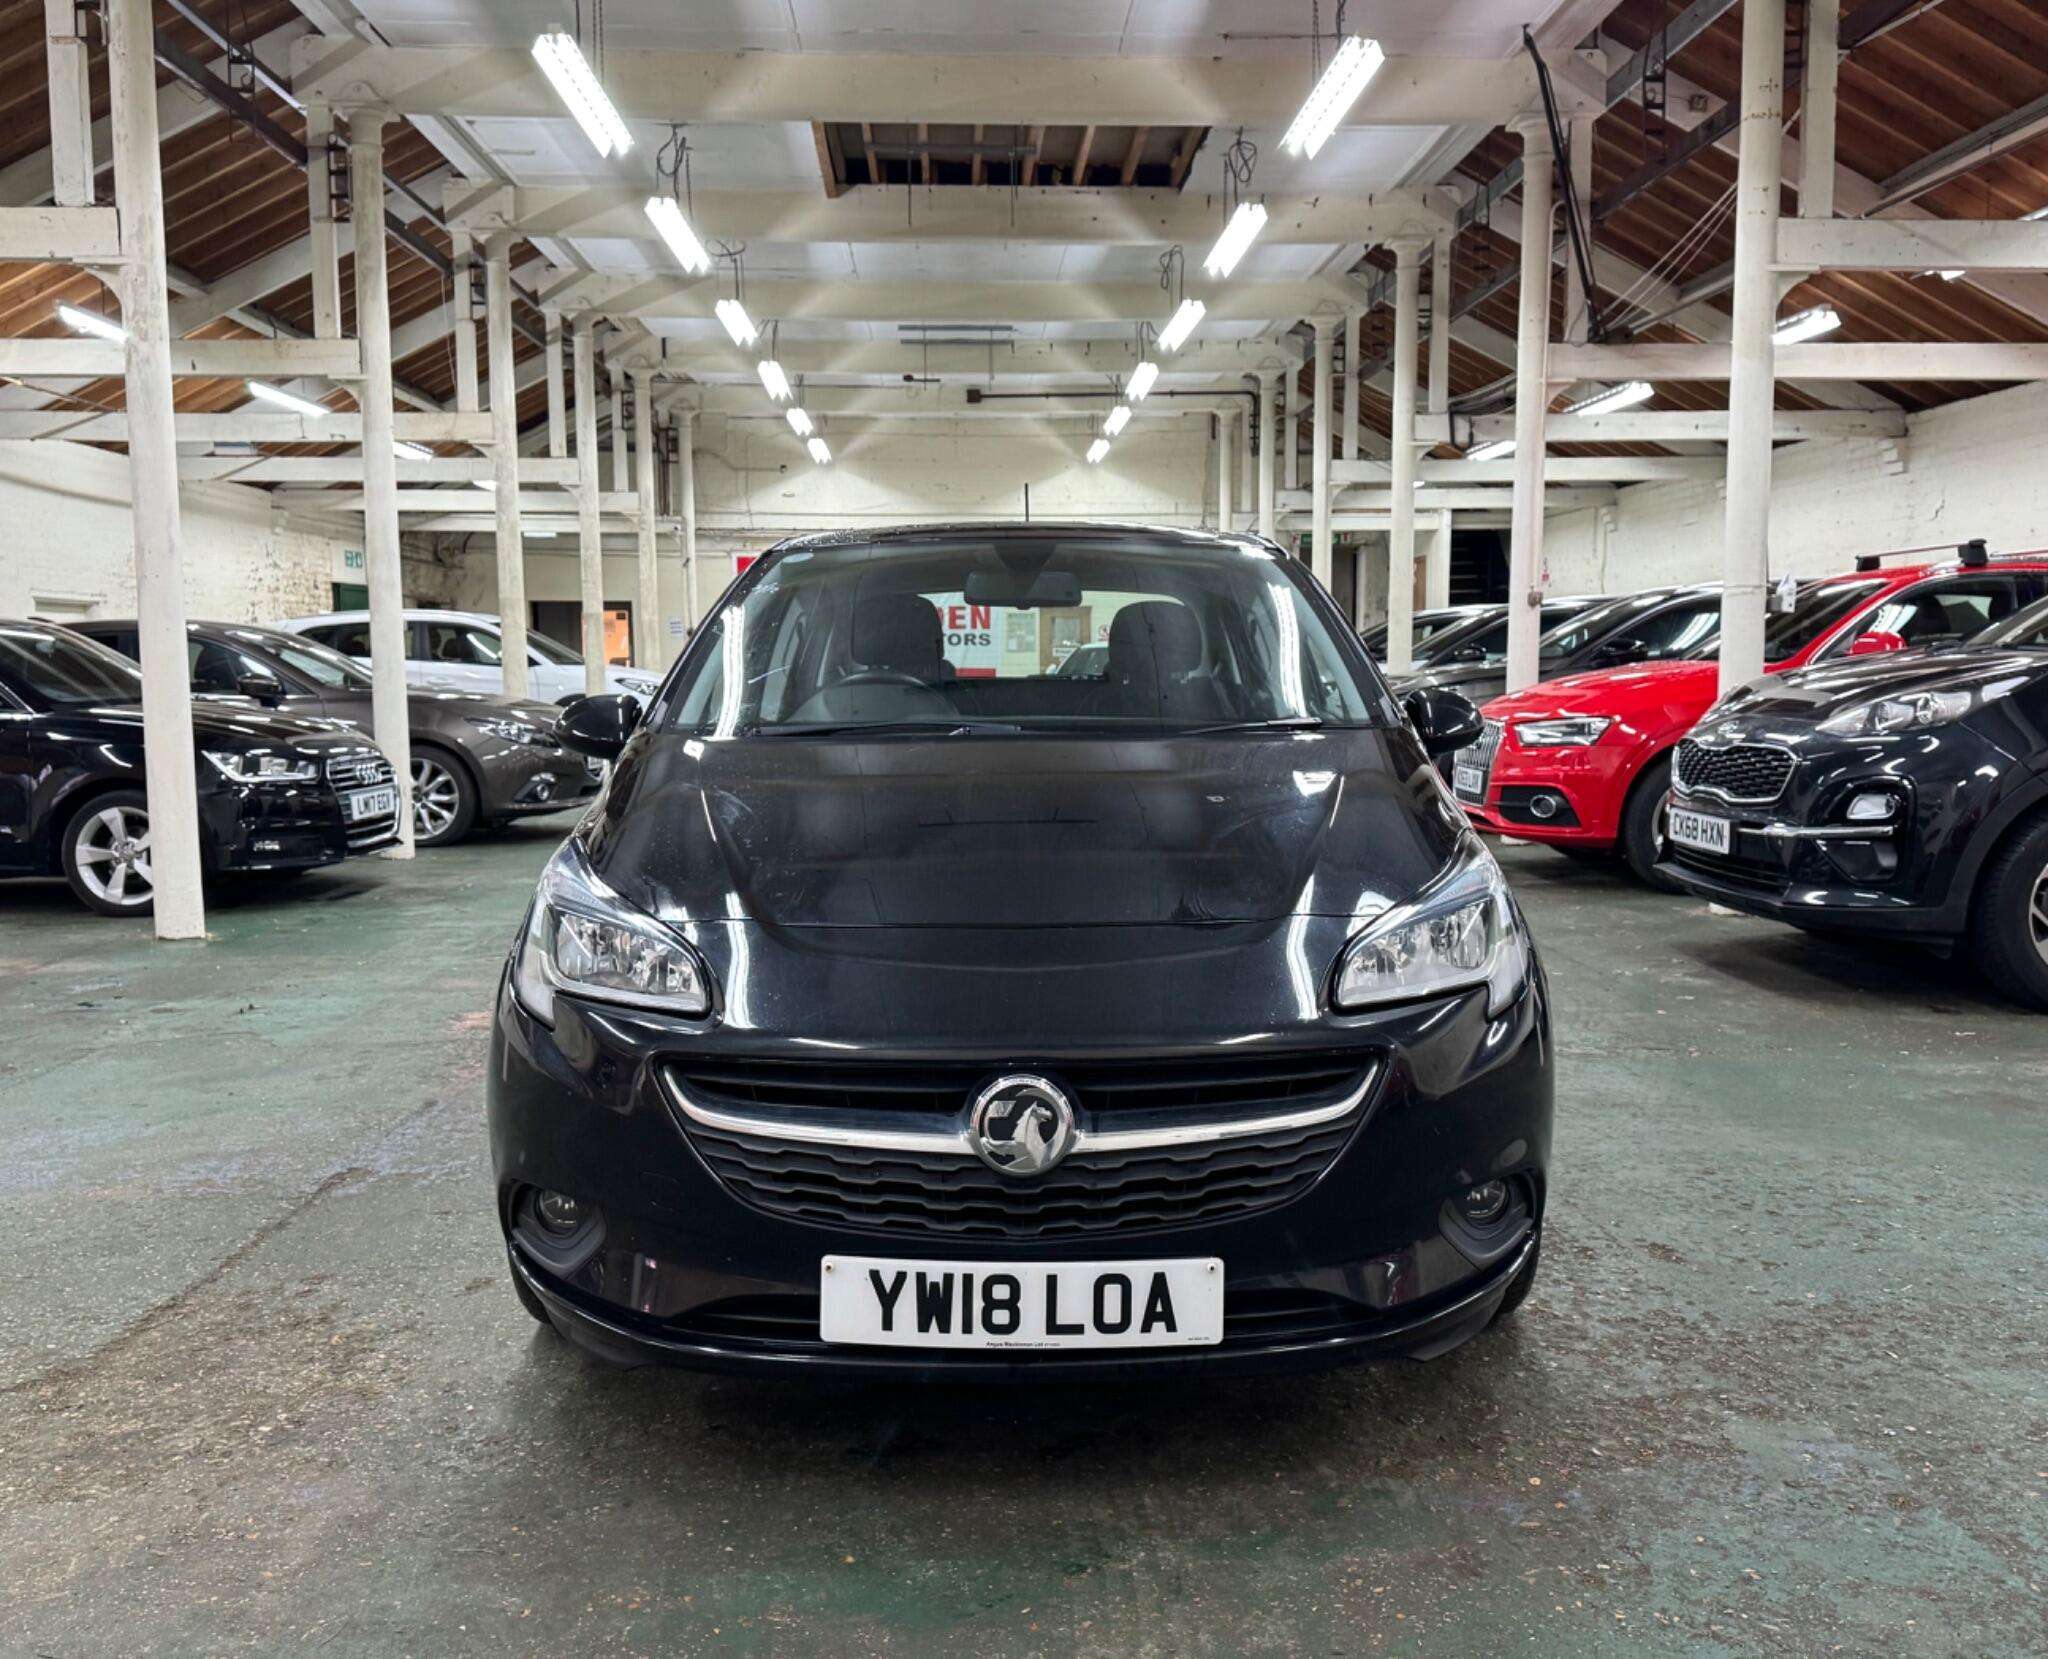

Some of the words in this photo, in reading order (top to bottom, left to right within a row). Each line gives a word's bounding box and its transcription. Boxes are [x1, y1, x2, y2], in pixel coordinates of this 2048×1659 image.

[943, 633, 991, 646] ORS
[1674, 812, 1699, 840] CK68
[1701, 818, 1725, 848] HXN
[868, 1268, 1021, 1335] YW18
[1046, 1271, 1178, 1335] LOA
